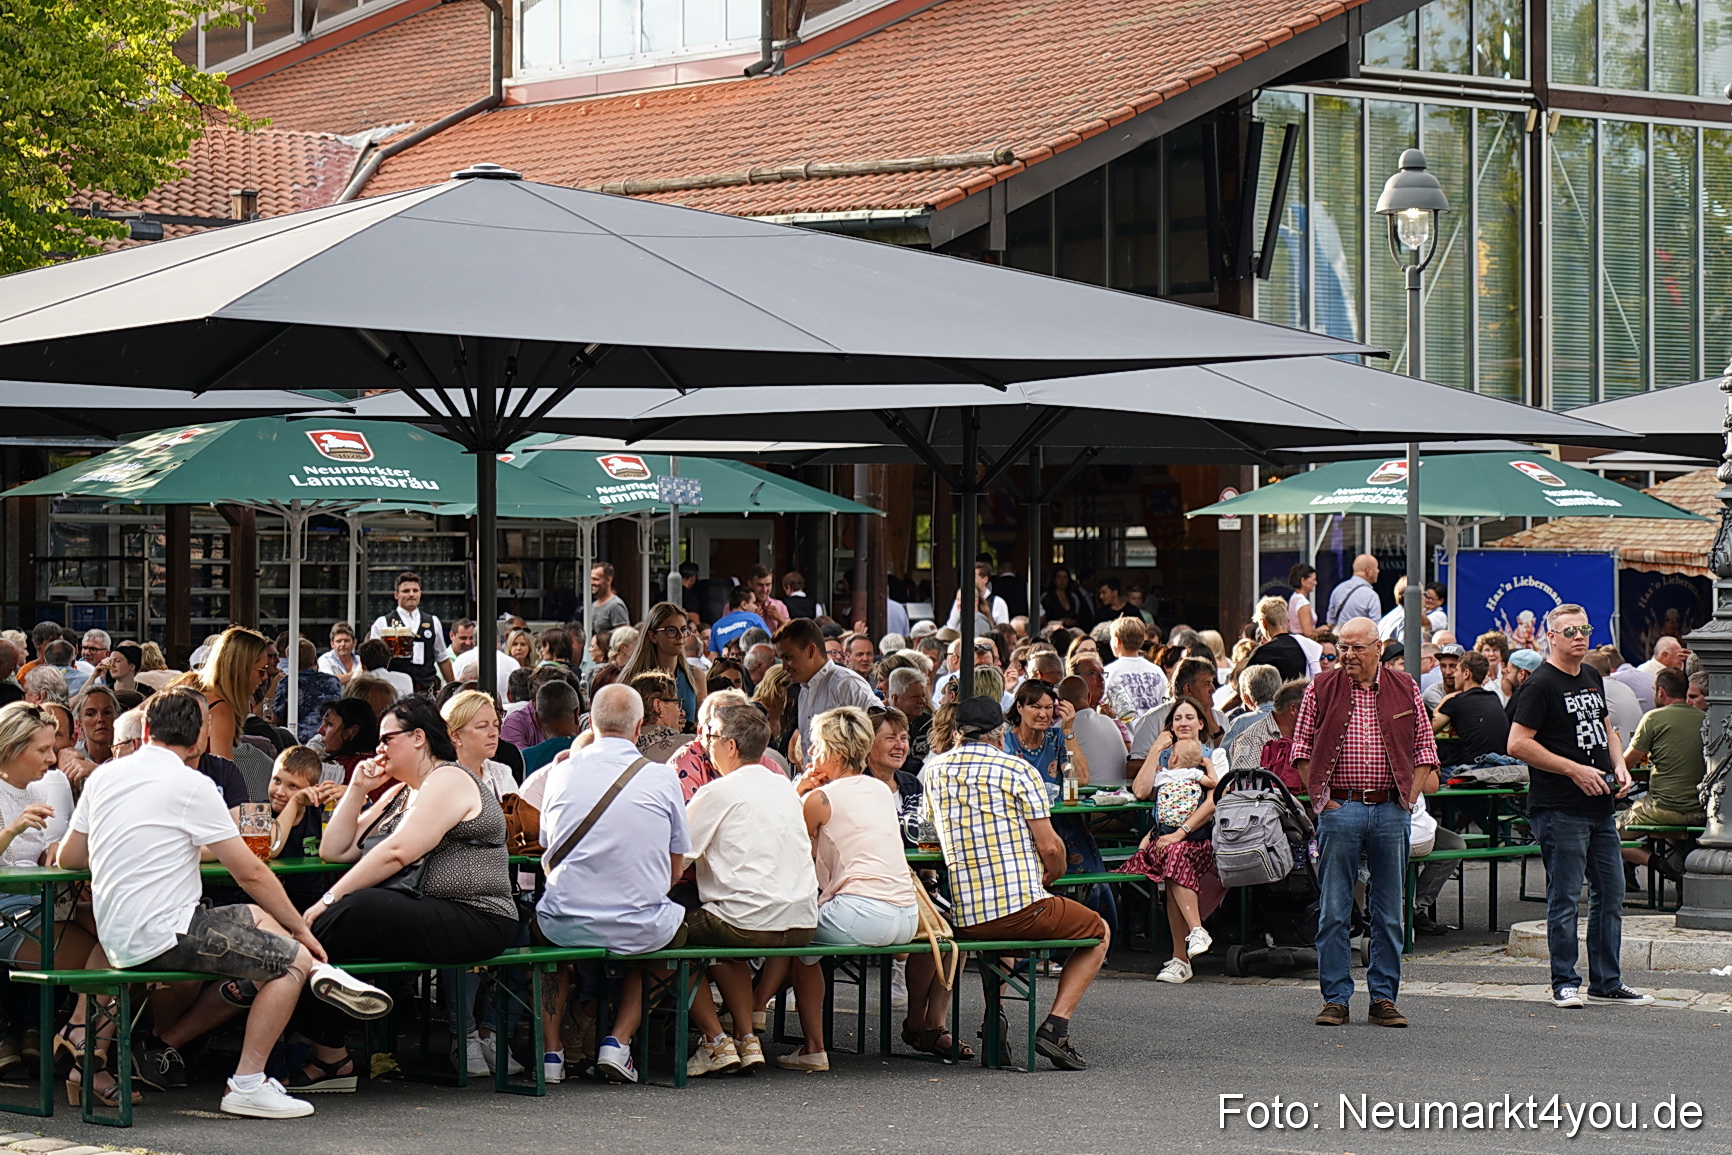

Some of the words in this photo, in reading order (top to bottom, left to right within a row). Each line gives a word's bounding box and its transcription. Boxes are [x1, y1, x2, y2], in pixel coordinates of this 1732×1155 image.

[303, 465, 410, 477] Neumarkter
[289, 474, 440, 490] Lammsbräu
[1564, 692, 1604, 713] BORN
[1577, 711, 1585, 720] IN
[1586, 708, 1600, 719] THE
